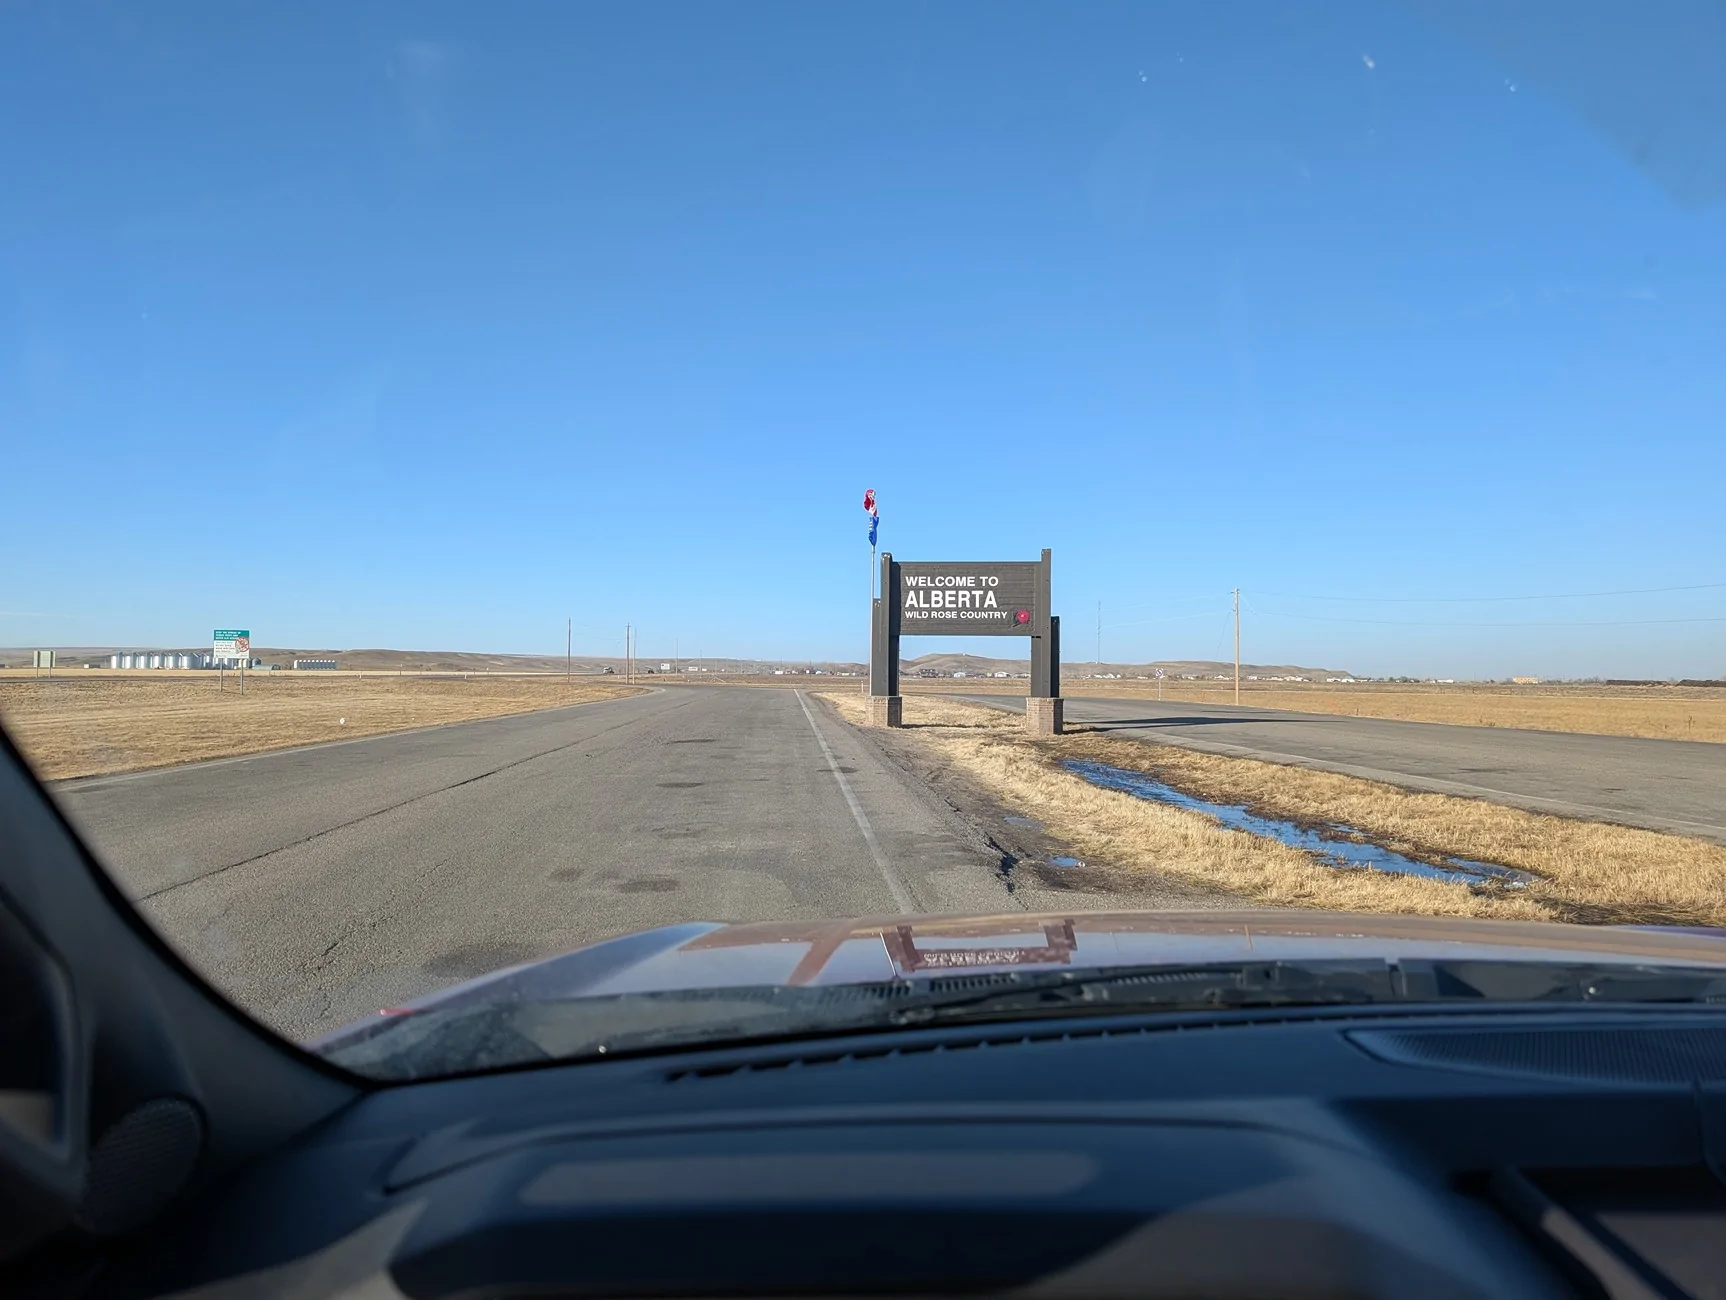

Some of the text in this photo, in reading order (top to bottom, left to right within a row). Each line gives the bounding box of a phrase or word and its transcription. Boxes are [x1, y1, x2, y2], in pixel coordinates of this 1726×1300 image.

[905, 576, 999, 587] WELCOME TO
[905, 590, 998, 608] ALBERTA
[905, 611, 1007, 619] WILD ROSE COUNTRY
